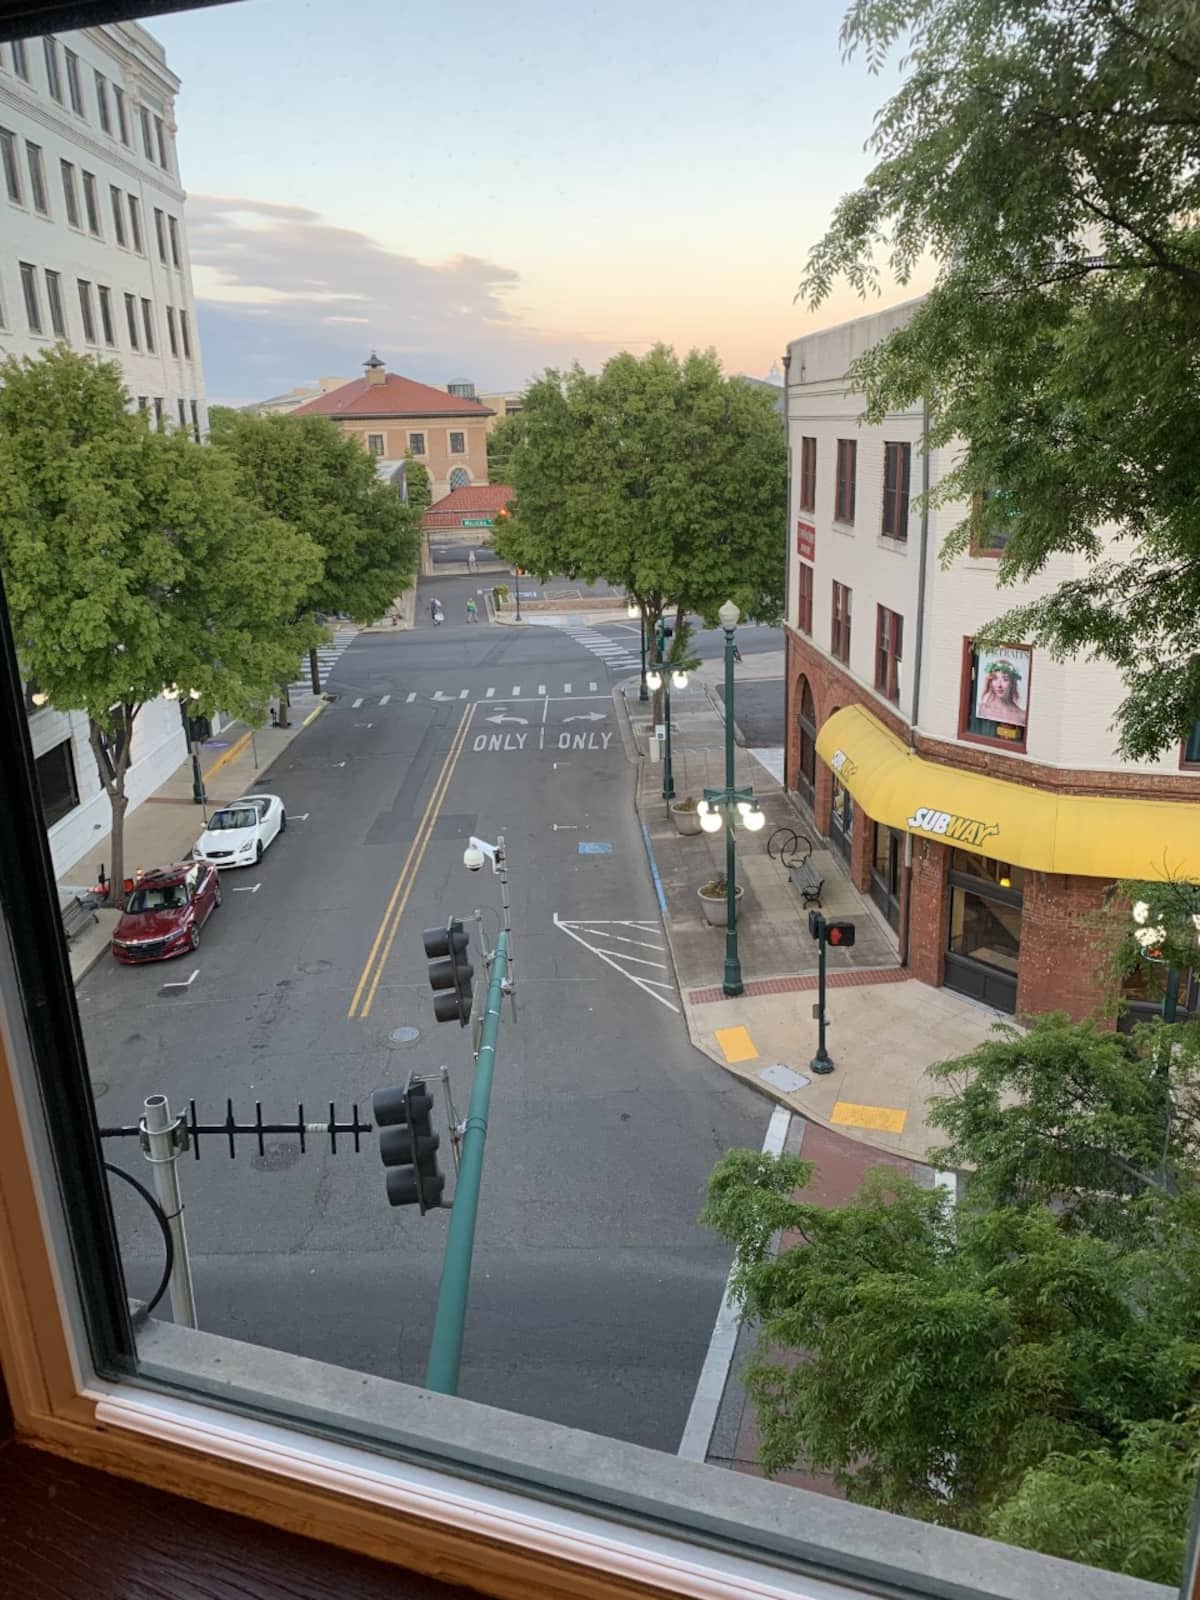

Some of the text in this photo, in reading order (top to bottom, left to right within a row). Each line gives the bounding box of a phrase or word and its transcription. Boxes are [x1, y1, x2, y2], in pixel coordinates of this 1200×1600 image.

[473, 733, 527, 751] ONLY
[558, 732, 612, 750] ONLY
[906, 807, 1000, 847] SUBWAY
